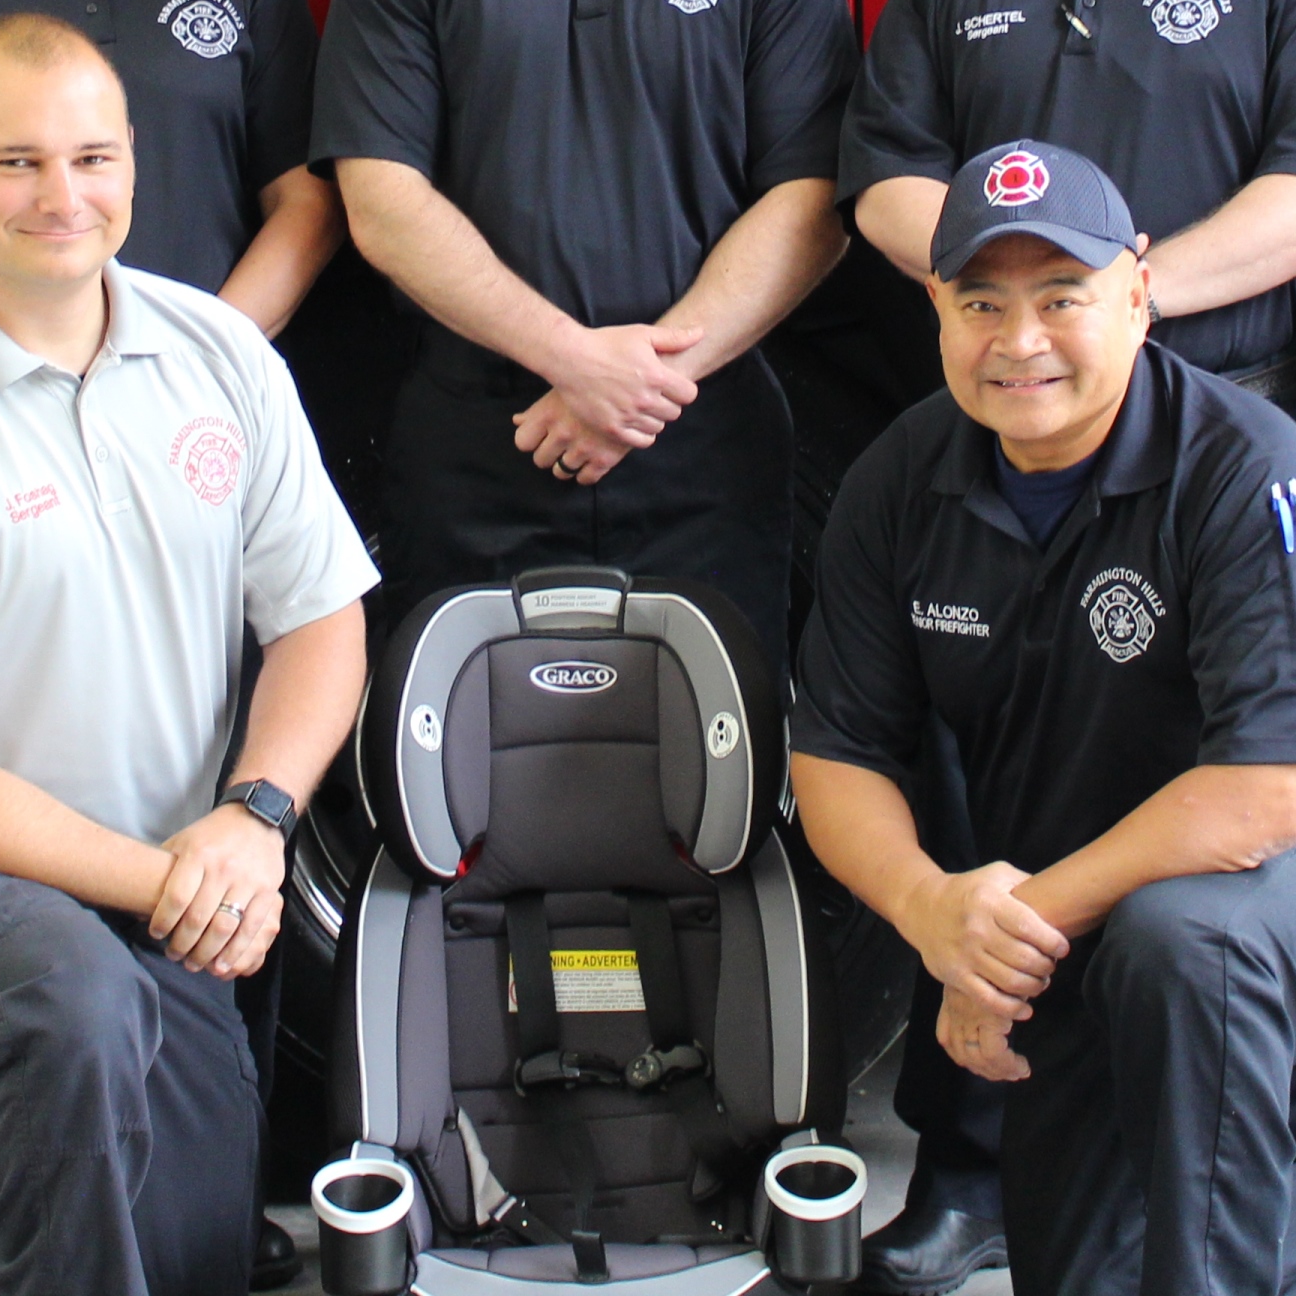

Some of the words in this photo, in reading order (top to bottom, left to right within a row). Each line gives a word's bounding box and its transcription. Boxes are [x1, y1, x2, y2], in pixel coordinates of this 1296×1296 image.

[222, 0, 245, 30] HILLS
[964, 10, 1026, 31] SCHERTEL
[967, 24, 1009, 41] Sergeant
[169, 416, 224, 465] FARMINGTON
[226, 421, 247, 452] HILLS
[10, 498, 60, 524] Sergeant
[535, 595, 550, 607] 10
[1080, 567, 1142, 608] FARMINGTON
[1140, 581, 1166, 617] HILLS
[926, 602, 979, 622] ALONZO
[935, 618, 990, 637] FIREFIGHTER
[543, 668, 610, 685] GRACO
[583, 955, 638, 967] ADVERTEN
